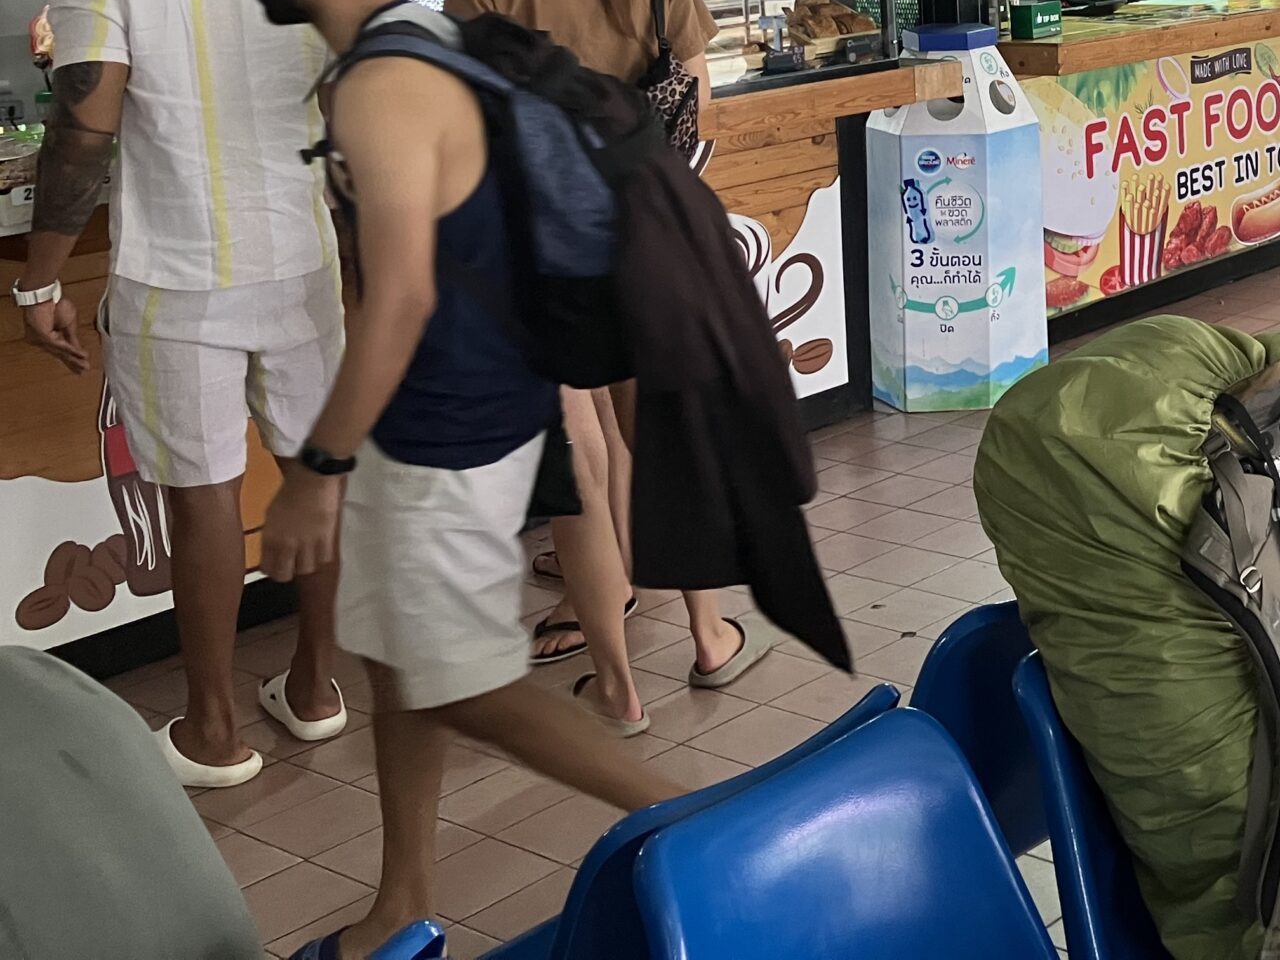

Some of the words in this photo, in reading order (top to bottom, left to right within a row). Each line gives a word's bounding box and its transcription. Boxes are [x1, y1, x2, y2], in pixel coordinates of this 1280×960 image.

[1194, 61, 1212, 79] MADE
[1213, 56, 1230, 75] WITH
[1232, 52, 1248, 69] LOVE
[1084, 100, 1192, 180] FAST
[1176, 159, 1226, 200] BEST
[1234, 150, 1259, 184] IN
[910, 248, 925, 268] 3
[929, 247, 982, 268] ขั้นตอน
